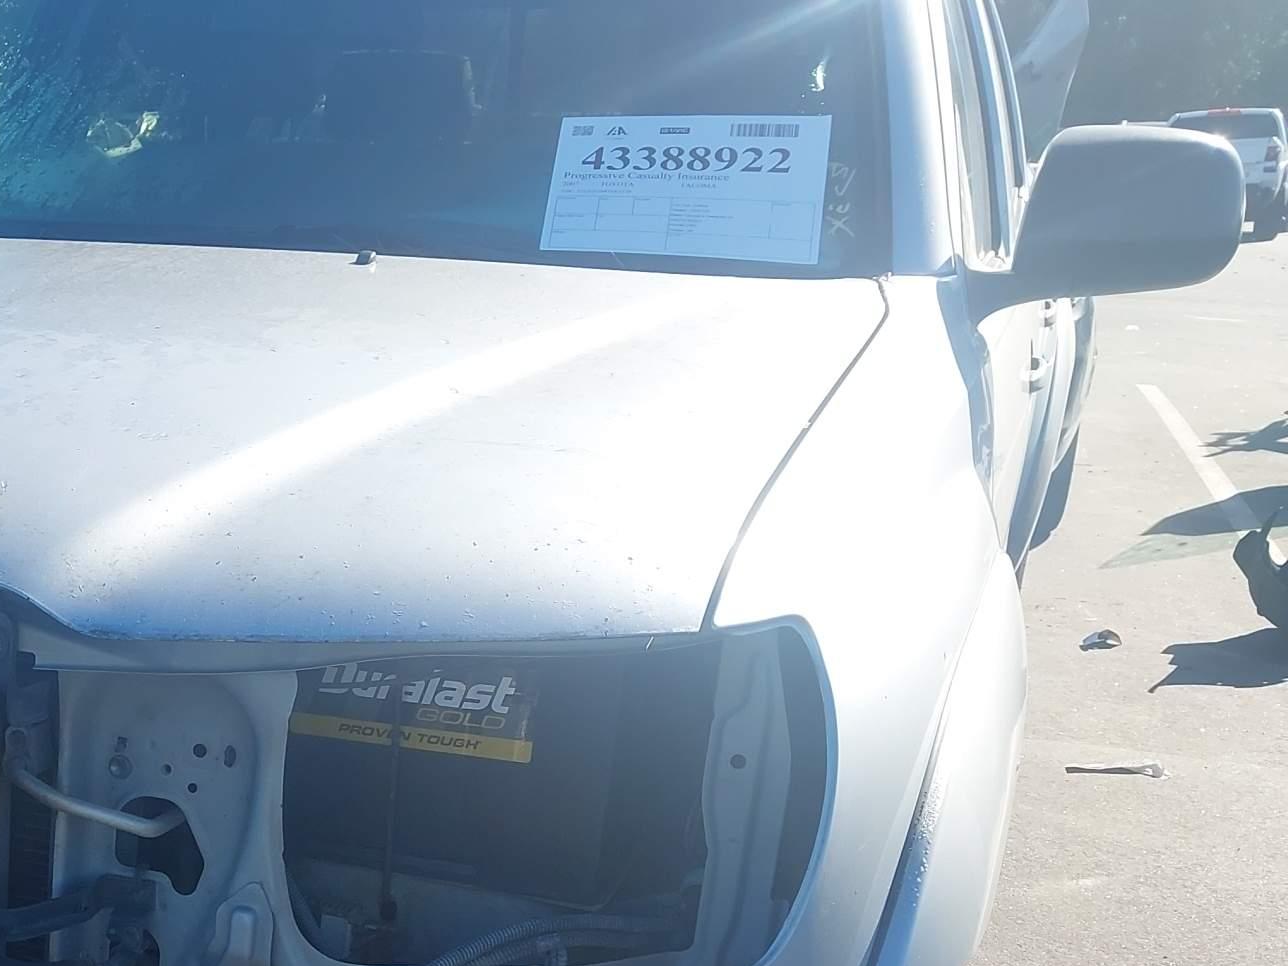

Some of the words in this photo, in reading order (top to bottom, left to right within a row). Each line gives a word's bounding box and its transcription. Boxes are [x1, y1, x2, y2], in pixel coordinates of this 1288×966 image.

[581, 146, 791, 173] 43388922
[564, 171, 624, 182] Progressive
[628, 172, 672, 182] Casualty
[677, 172, 730, 182] Insurance
[318, 663, 515, 714] Duralast
[416, 707, 505, 729] GOLD
[417, 732, 480, 750] TOUGH
